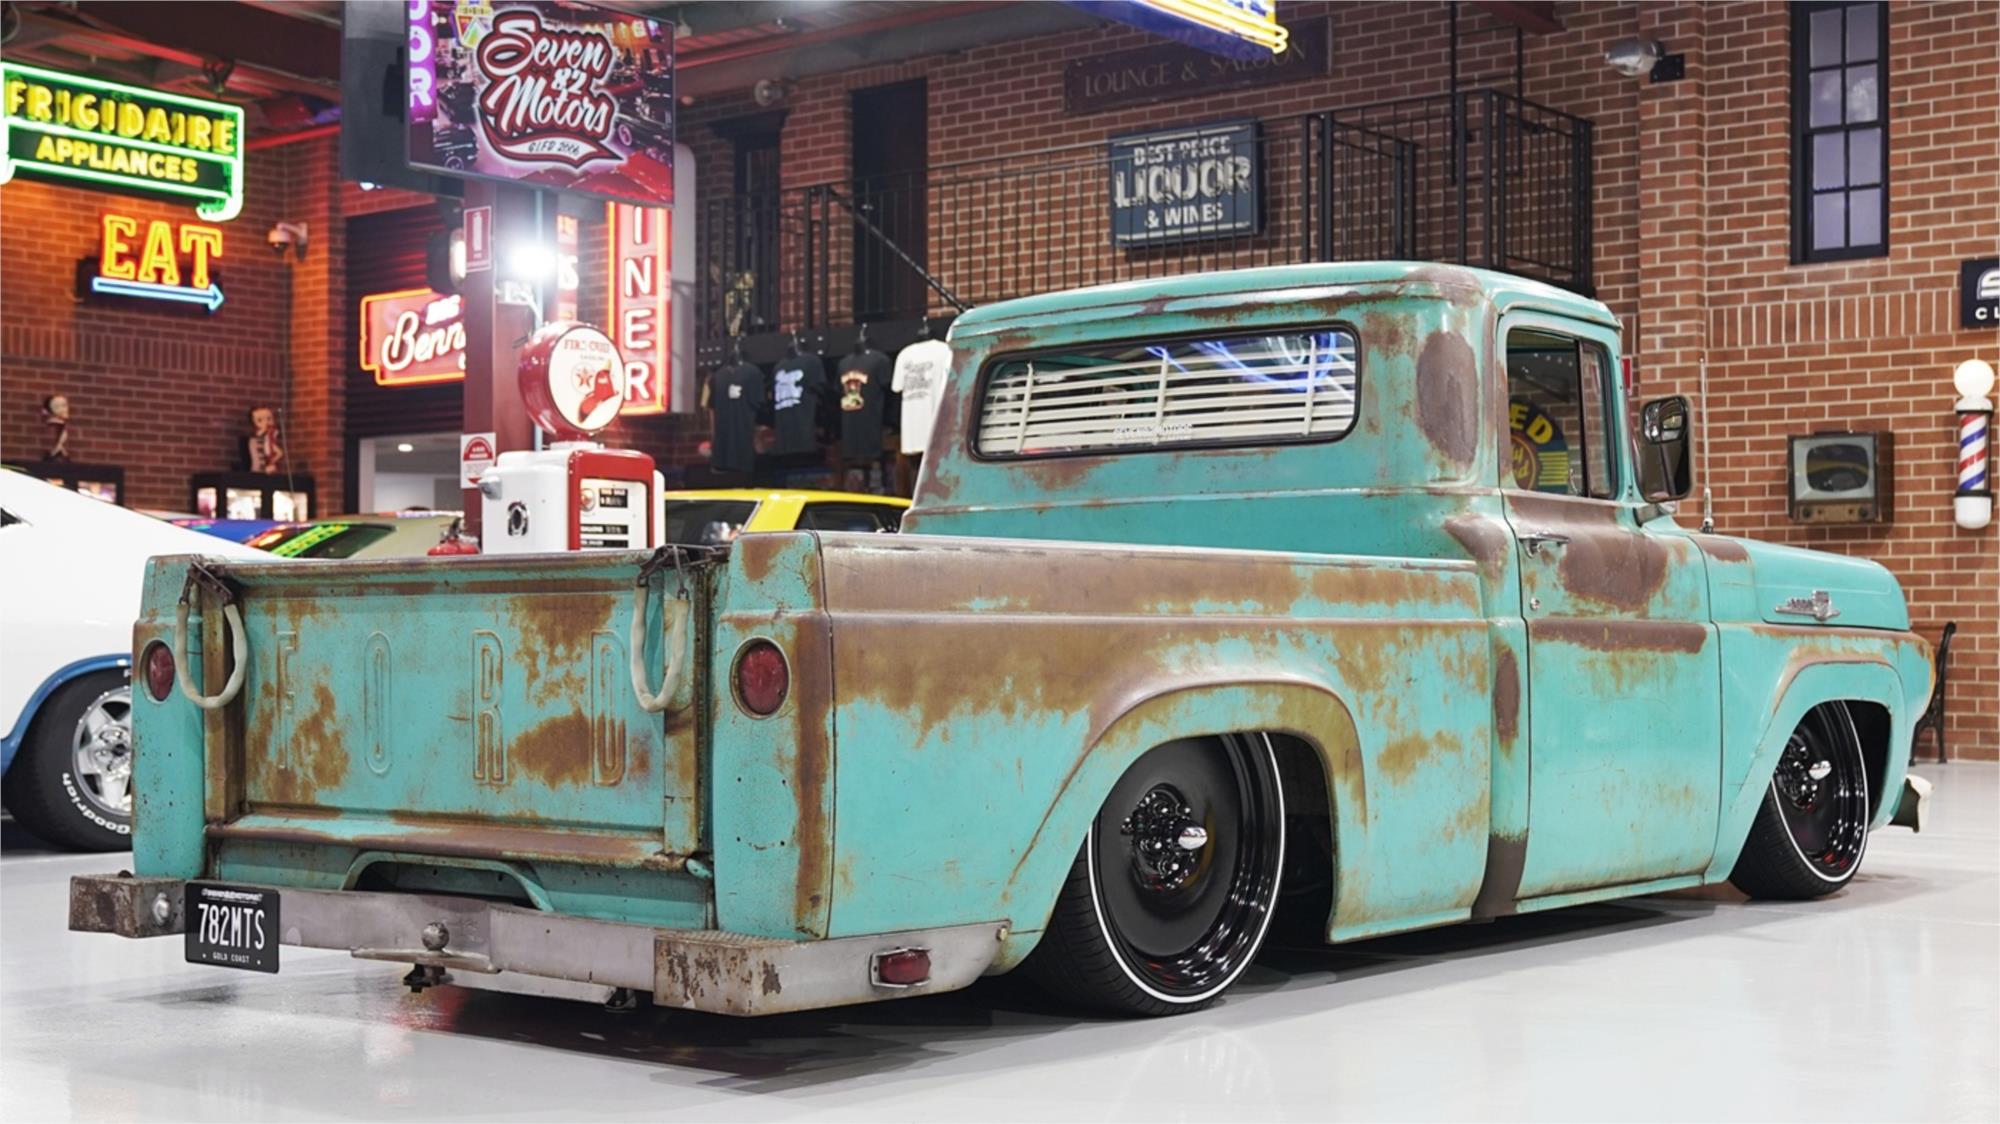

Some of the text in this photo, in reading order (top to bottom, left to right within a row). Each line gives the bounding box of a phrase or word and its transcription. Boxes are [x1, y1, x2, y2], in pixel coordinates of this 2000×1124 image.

[484, 19, 608, 76] Seven
[486, 74, 609, 133] Motors
[551, 67, 587, 94] 82
[1084, 62, 1171, 98] LOUNGE
[1181, 60, 1198, 82] &
[5, 78, 236, 154] FRIGIDAIRE
[36, 135, 199, 183] APPLIANCES
[1134, 136, 1230, 166] BEST PRICE
[1114, 156, 1251, 208] LIQUOR
[1144, 203, 1223, 229] & WINES
[103, 214, 223, 289] EAT
[276, 629, 628, 787] FORD
[62, 772, 131, 835] Goodrich
[198, 903, 265, 950] 782MTS
[212, 952, 250, 963] GOLD COAST
